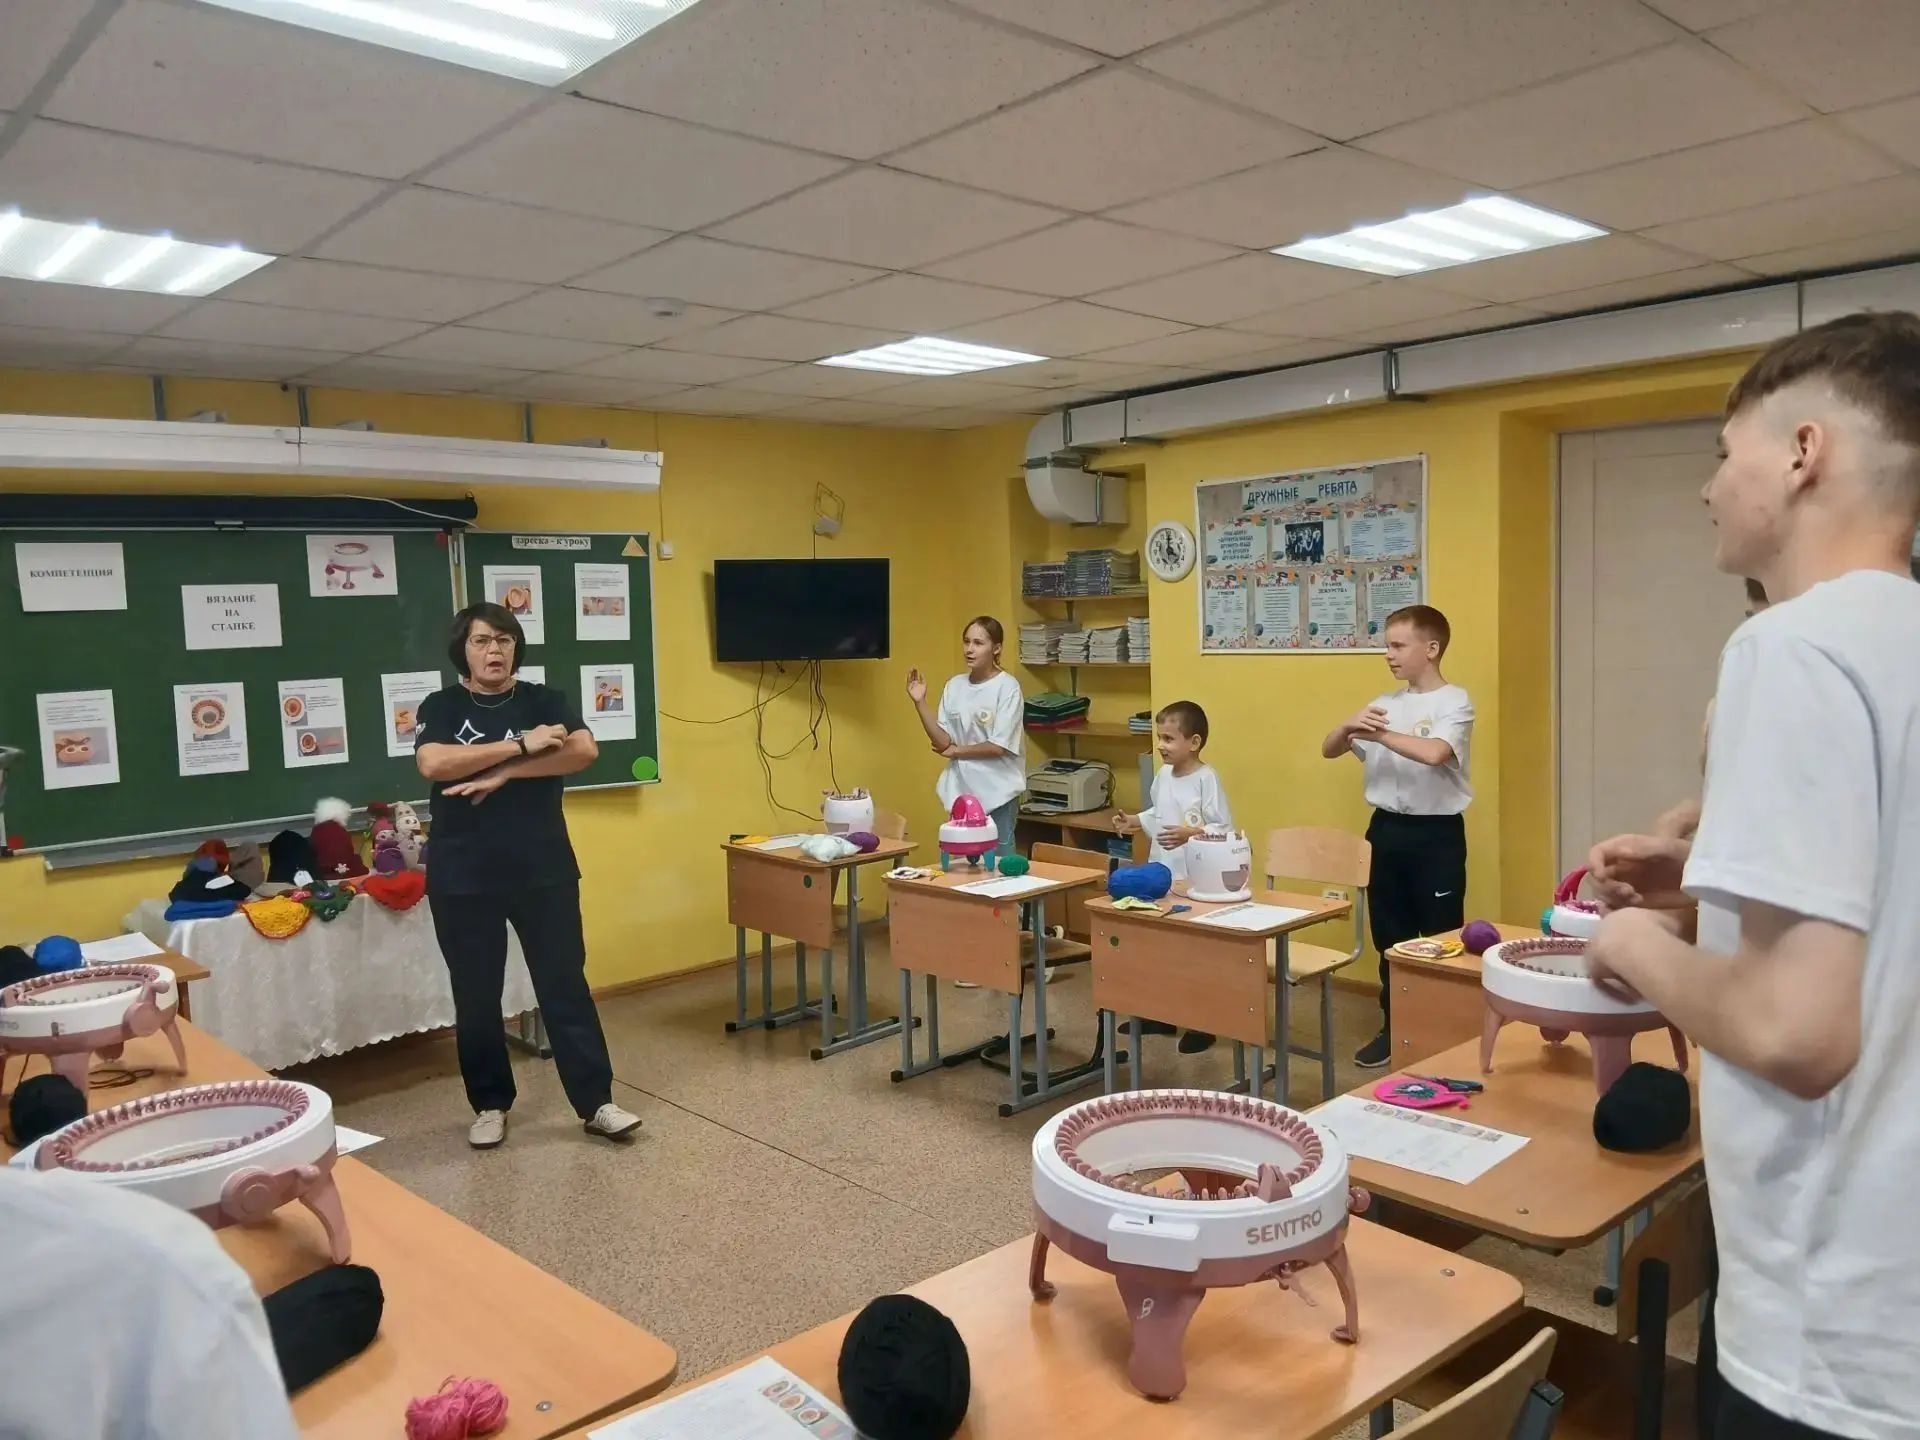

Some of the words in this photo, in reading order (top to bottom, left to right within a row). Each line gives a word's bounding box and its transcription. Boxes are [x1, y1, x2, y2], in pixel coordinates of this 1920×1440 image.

[1248, 487, 1299, 503] ДРУЖНЫЕ
[1319, 481, 1357, 493] РЕБЯТА
[564, 538, 589, 547] уроку
[30, 568, 113, 578] КОМПЕТЕНЦИЯ
[206, 594, 256, 604] ВЯЗАНИЕ
[225, 609, 240, 617] НА
[211, 622, 256, 631] СТАНКЕ
[1246, 1209, 1322, 1245] SENTRO
